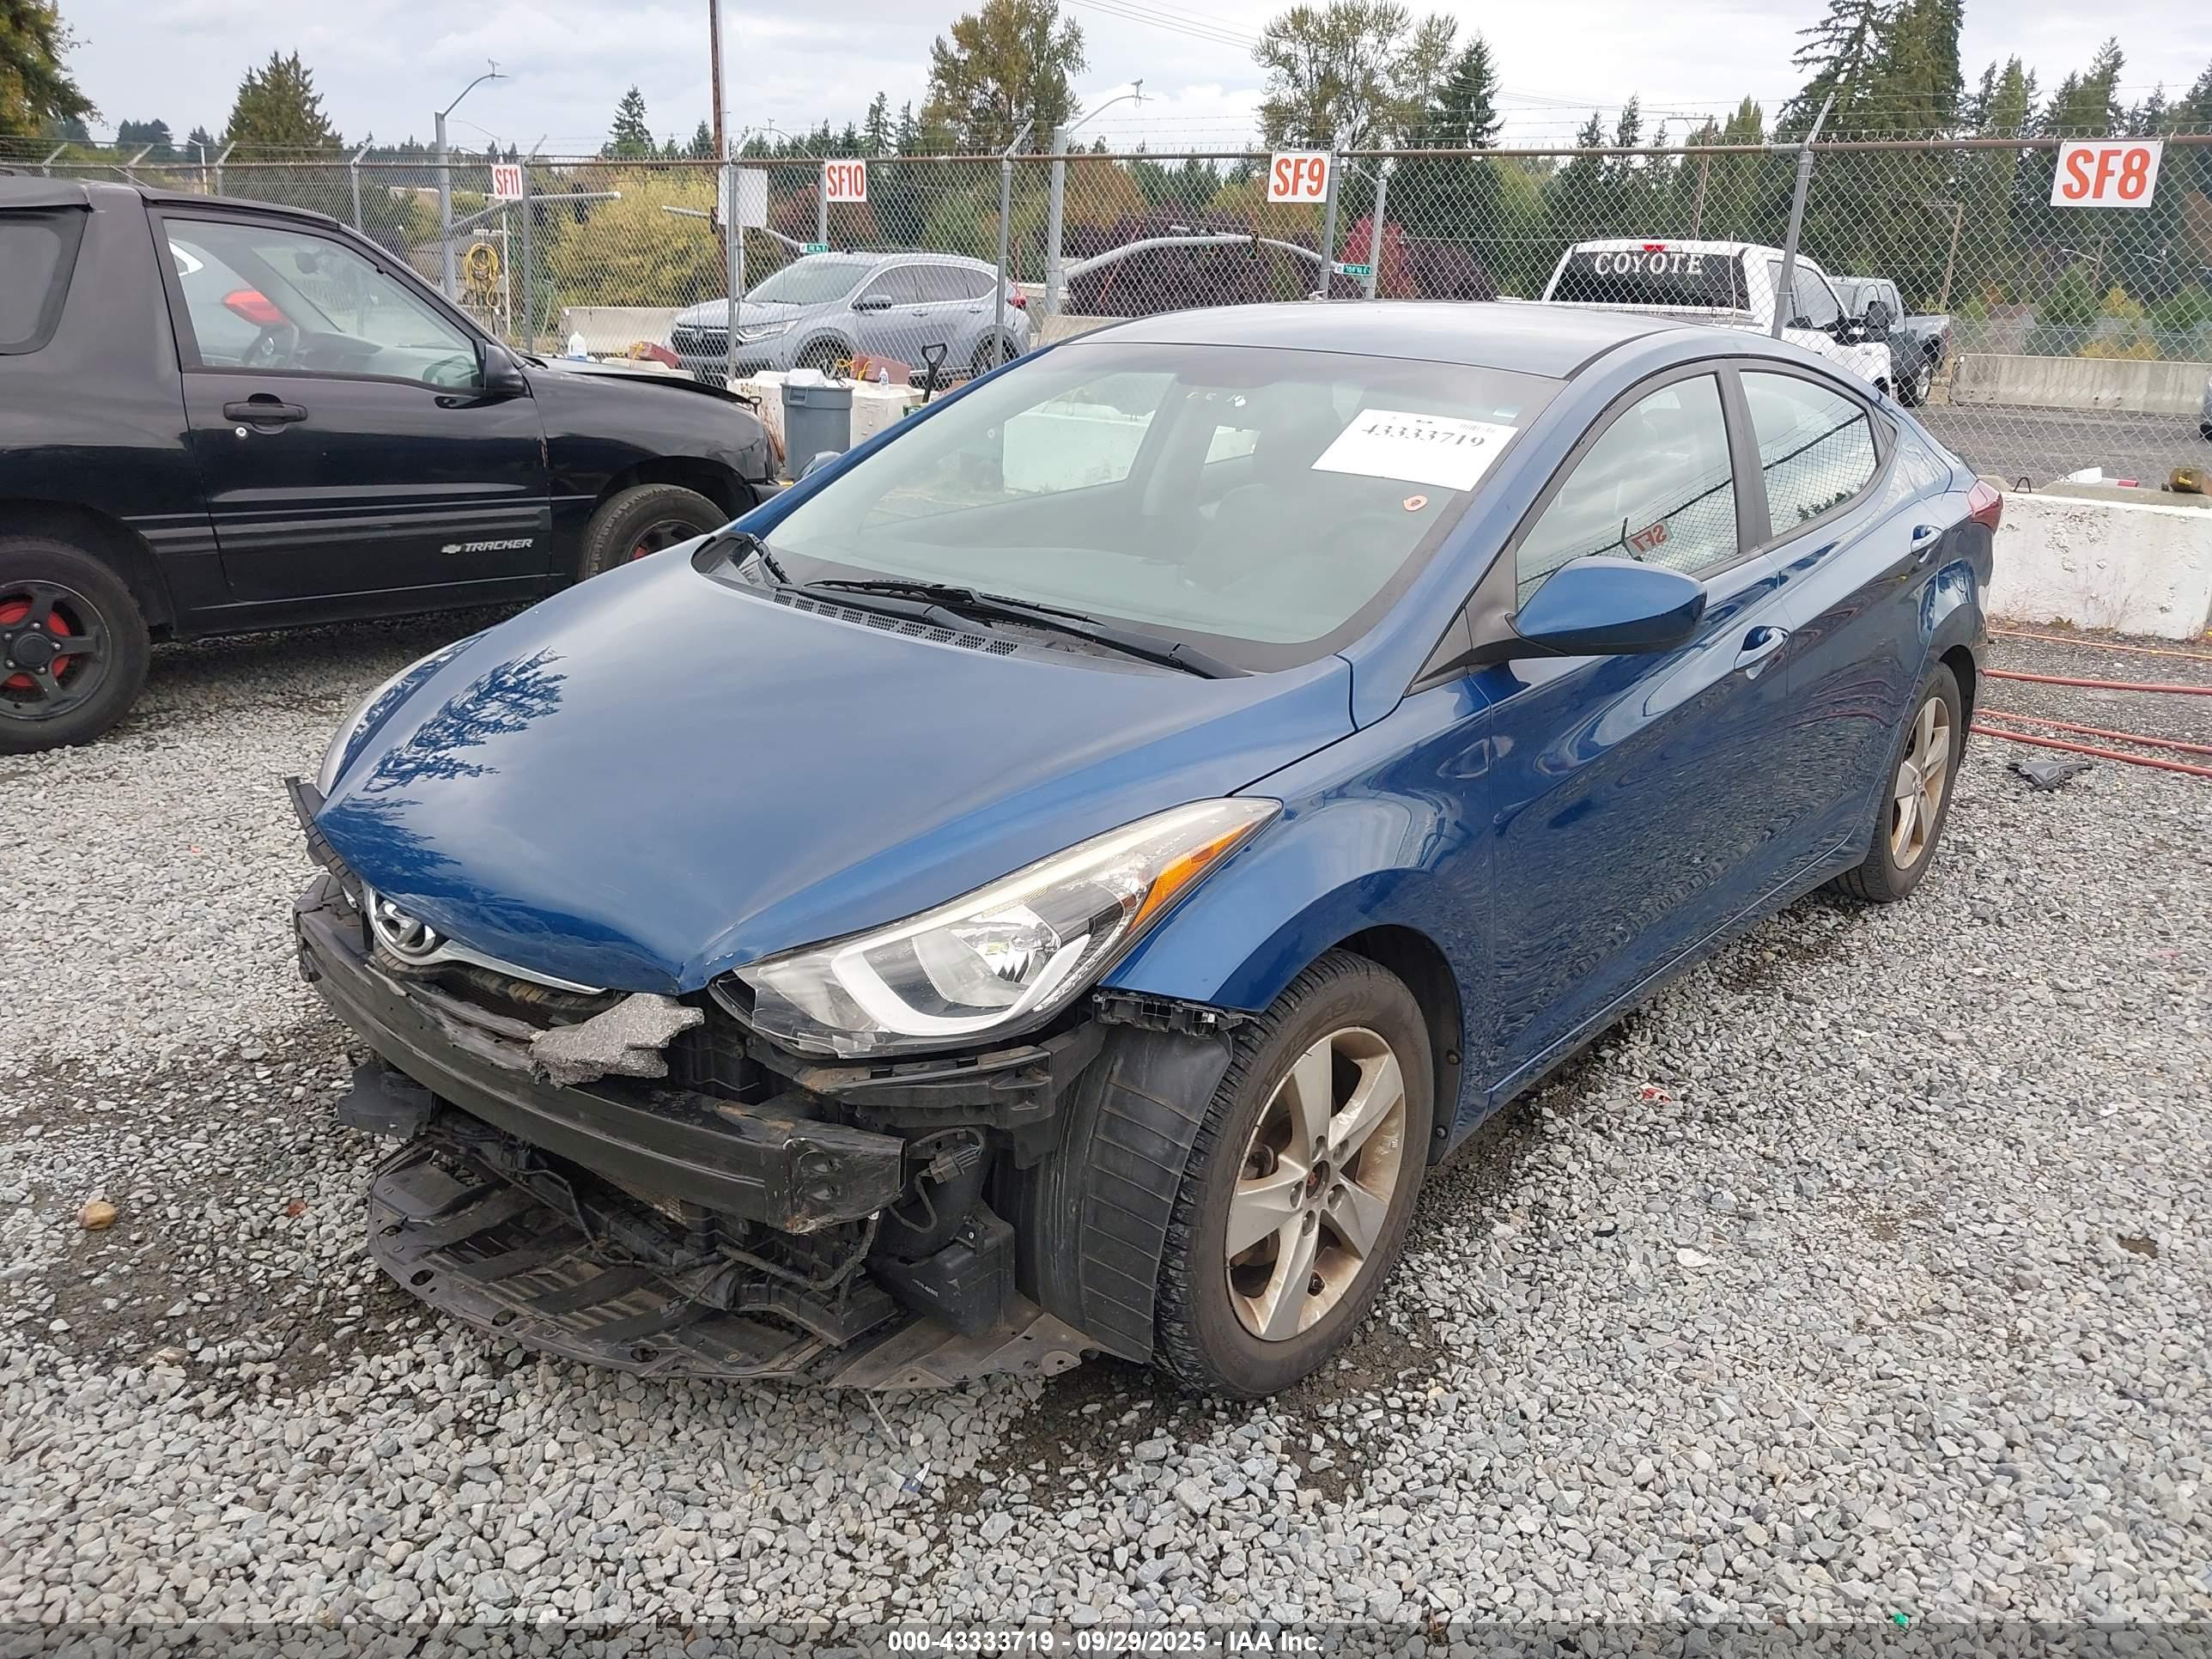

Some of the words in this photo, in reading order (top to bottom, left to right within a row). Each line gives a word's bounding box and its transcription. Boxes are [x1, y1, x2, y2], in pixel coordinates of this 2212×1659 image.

[495, 168, 520, 196] SF11
[827, 165, 865, 197] SF10
[1273, 158, 1325, 197] SF9
[2063, 148, 2151, 200] SF8
[1595, 252, 1705, 275] COYOTE
[1361, 423, 1486, 447] 43333719
[465, 538, 533, 553] TRACKER
